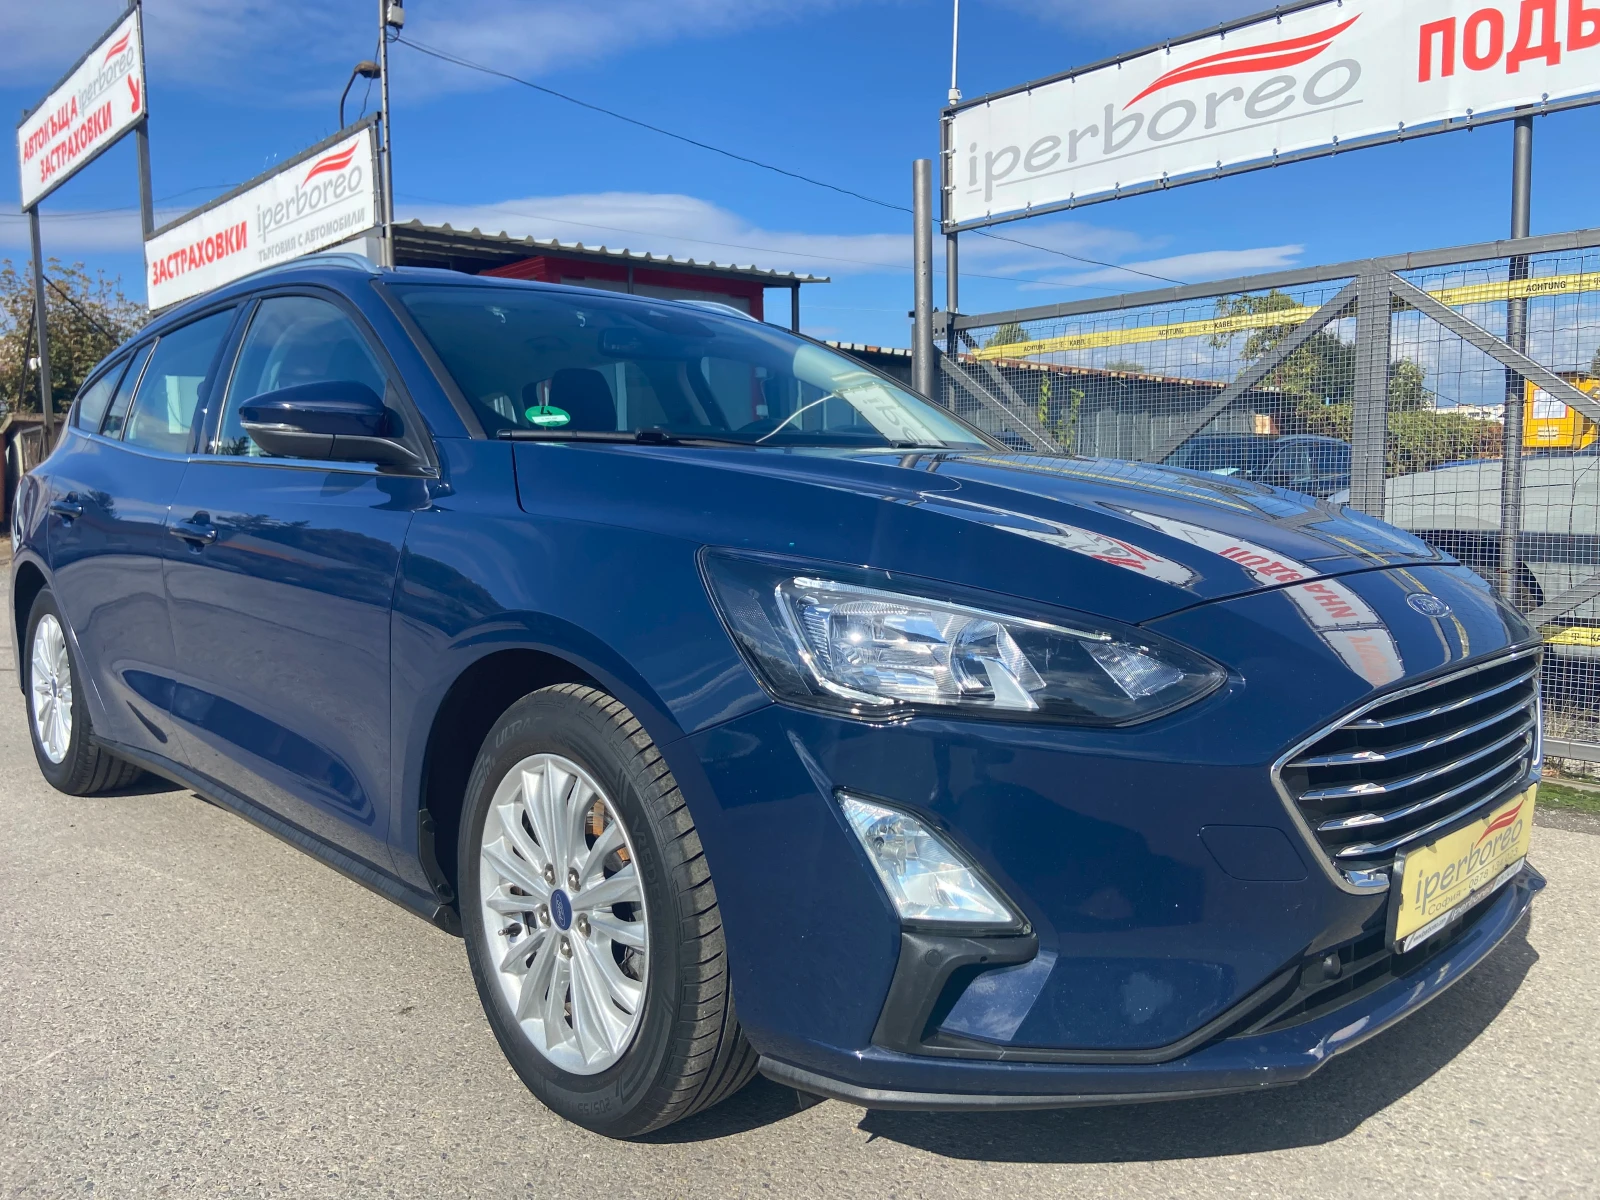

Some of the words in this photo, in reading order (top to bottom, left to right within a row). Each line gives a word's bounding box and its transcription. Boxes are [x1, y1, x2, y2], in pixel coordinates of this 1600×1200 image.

[79, 46, 134, 118] iperboreo
[23, 96, 78, 164] АВТОКЪЩА
[40, 101, 113, 183] ЗАСТРАХОВКИ
[967, 59, 1362, 202] iperboreo
[257, 165, 362, 243] iperboreo
[258, 237, 296, 263] ТЪРГОВИЯ
[298, 234, 303, 246] С
[304, 207, 365, 245] АВТОМОБИЛИ
[152, 221, 248, 286] ЗАСТРАХОВКИ
[1526, 281, 1566, 292] ACHTUNG
[1023, 344, 1046, 352] ACHTUNG
[1158, 328, 1184, 336] ACHTUNG
[1215, 320, 1233, 328] KABEL
[1415, 819, 1523, 915] iperboreo
[1428, 889, 1461, 916] София
[1469, 868, 1489, 889] 0878
